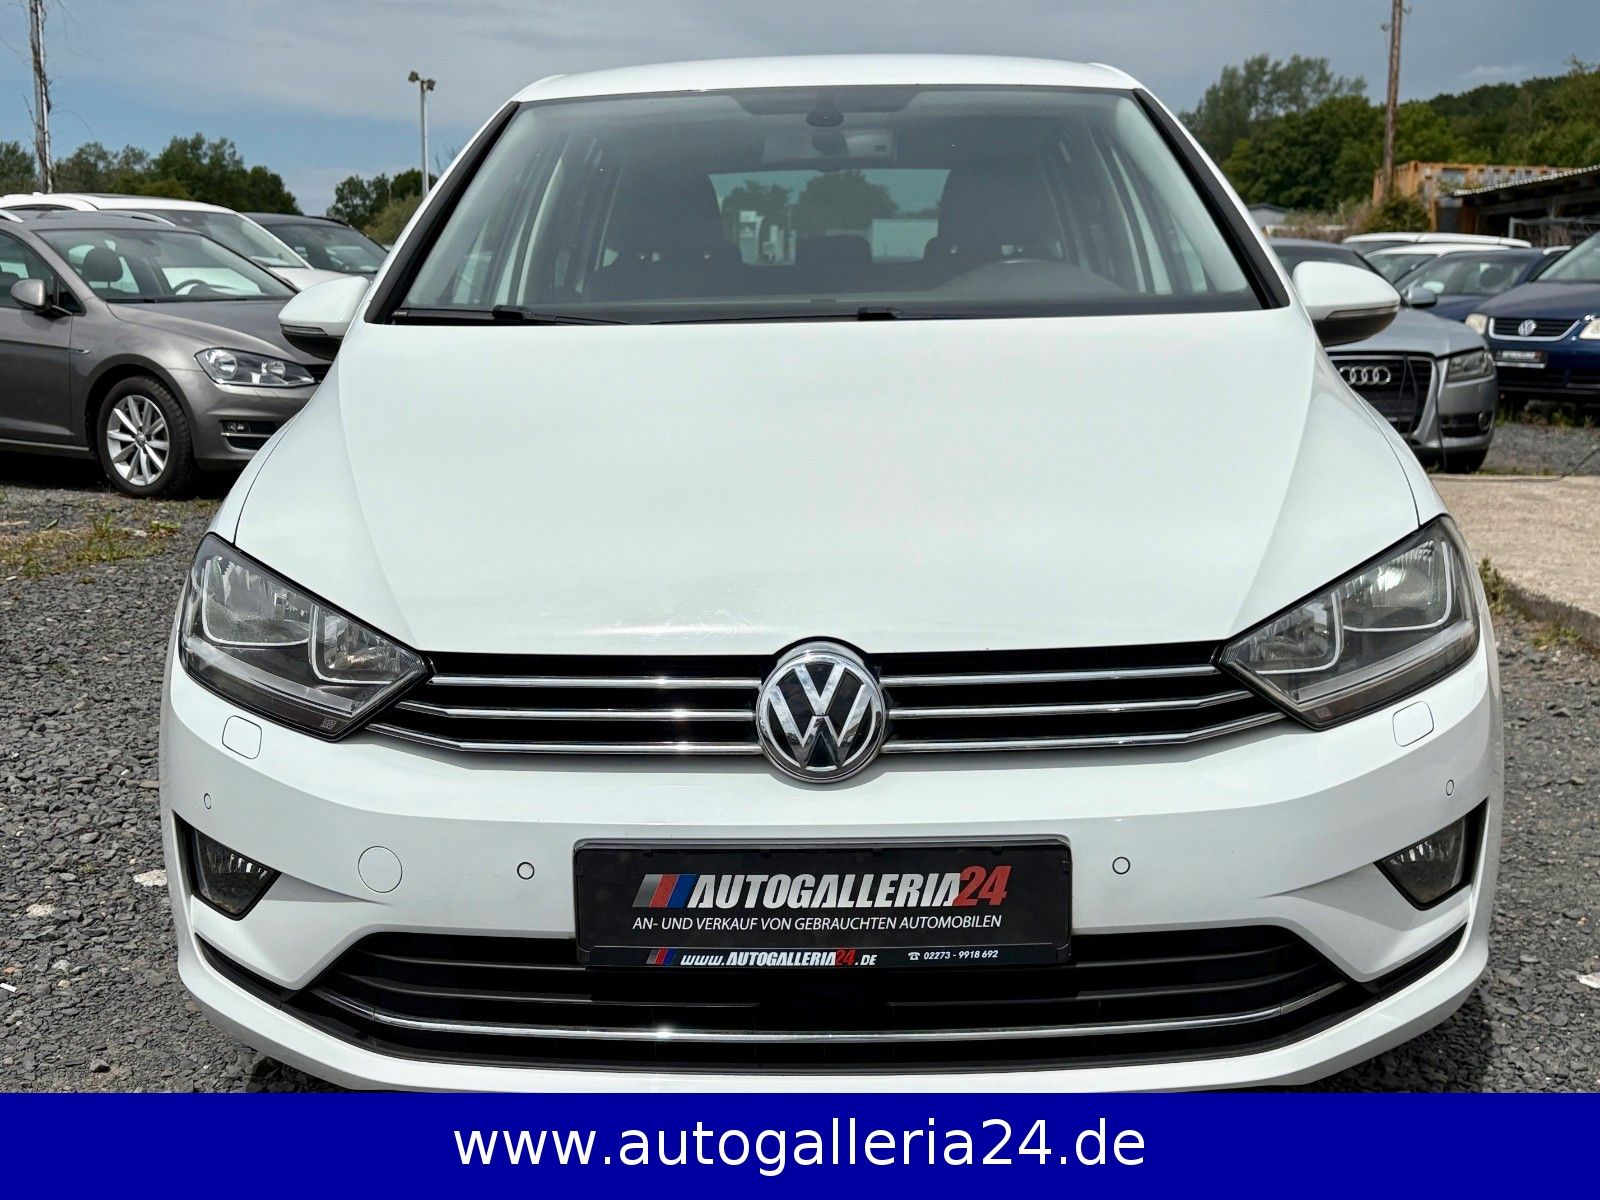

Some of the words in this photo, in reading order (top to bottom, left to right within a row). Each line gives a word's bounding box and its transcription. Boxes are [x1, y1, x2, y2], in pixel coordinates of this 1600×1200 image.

[686, 866, 1012, 909] AUTOGALLERIA24
[632, 917, 659, 930] AN-
[661, 917, 693, 930] UND
[696, 917, 758, 931] VERKAUF
[761, 917, 792, 931] VON
[794, 916, 898, 931] GEBRAUCHTEN
[898, 915, 1002, 930] AUTOMOBILEN
[923, 951, 951, 960] 02273
[958, 950, 981, 960] 9918
[981, 949, 999, 959] 692
